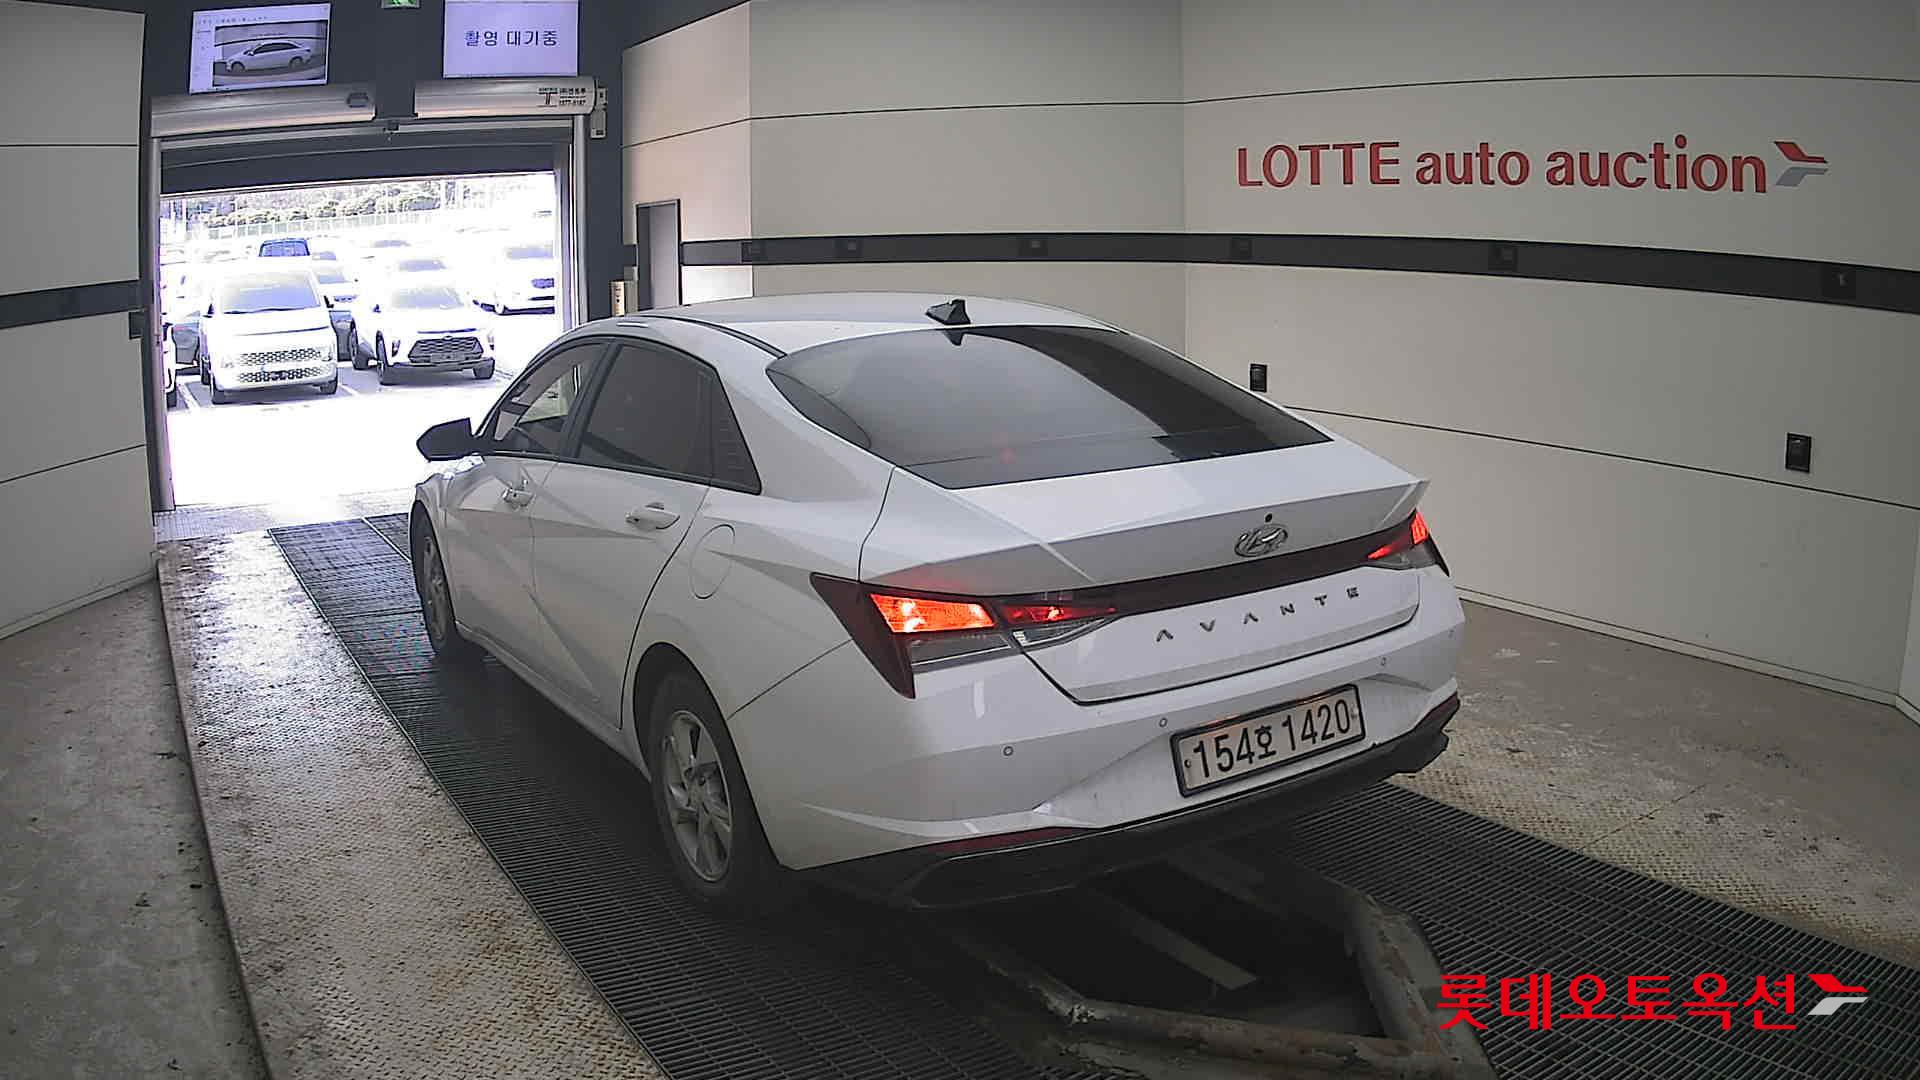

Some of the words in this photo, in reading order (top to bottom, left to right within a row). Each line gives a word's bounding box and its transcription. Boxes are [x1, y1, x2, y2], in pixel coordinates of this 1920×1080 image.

[465, 30, 498, 46] 촬영
[506, 30, 557, 46] 대기중
[1237, 141, 1400, 187] LOTTE
[1415, 141, 1530, 186] auto
[1545, 134, 1767, 193] auction
[1156, 586, 1359, 642] AVANTE
[1193, 725, 1276, 778] 154호
[1282, 699, 1350, 751] 1420
